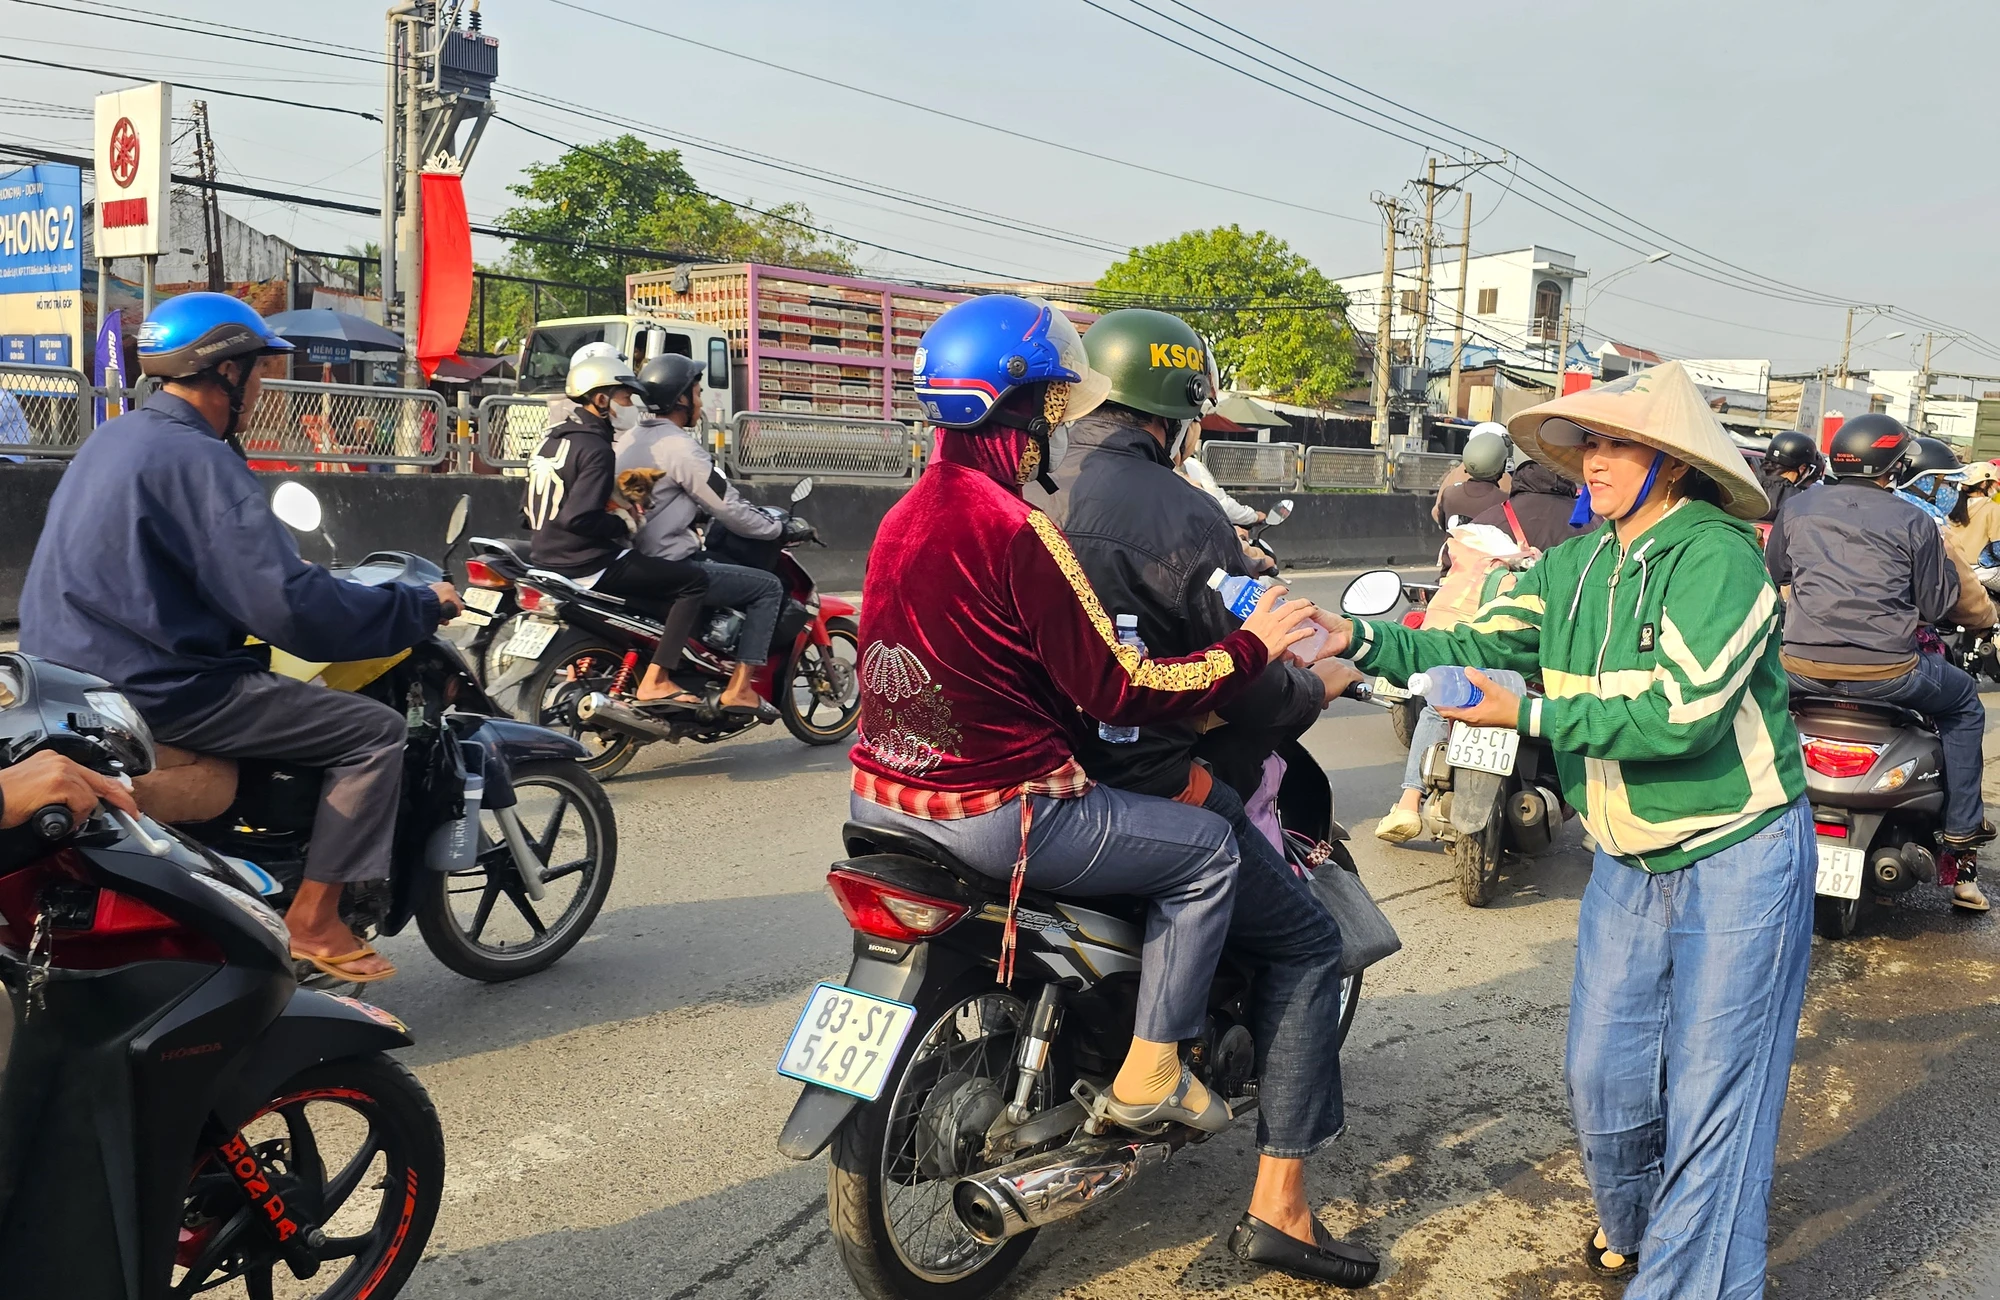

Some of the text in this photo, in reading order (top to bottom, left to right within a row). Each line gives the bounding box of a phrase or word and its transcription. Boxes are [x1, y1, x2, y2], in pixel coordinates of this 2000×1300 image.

[63, 205, 74, 250] 2
[101, 197, 148, 229] YAMAHA
[1462, 726, 1508, 750] 79-C1
[1452, 744, 1511, 771] 353.10
[868, 944, 897, 955] HONDA
[796, 1033, 879, 1088] 5497
[220, 1134, 298, 1242] HONDA
